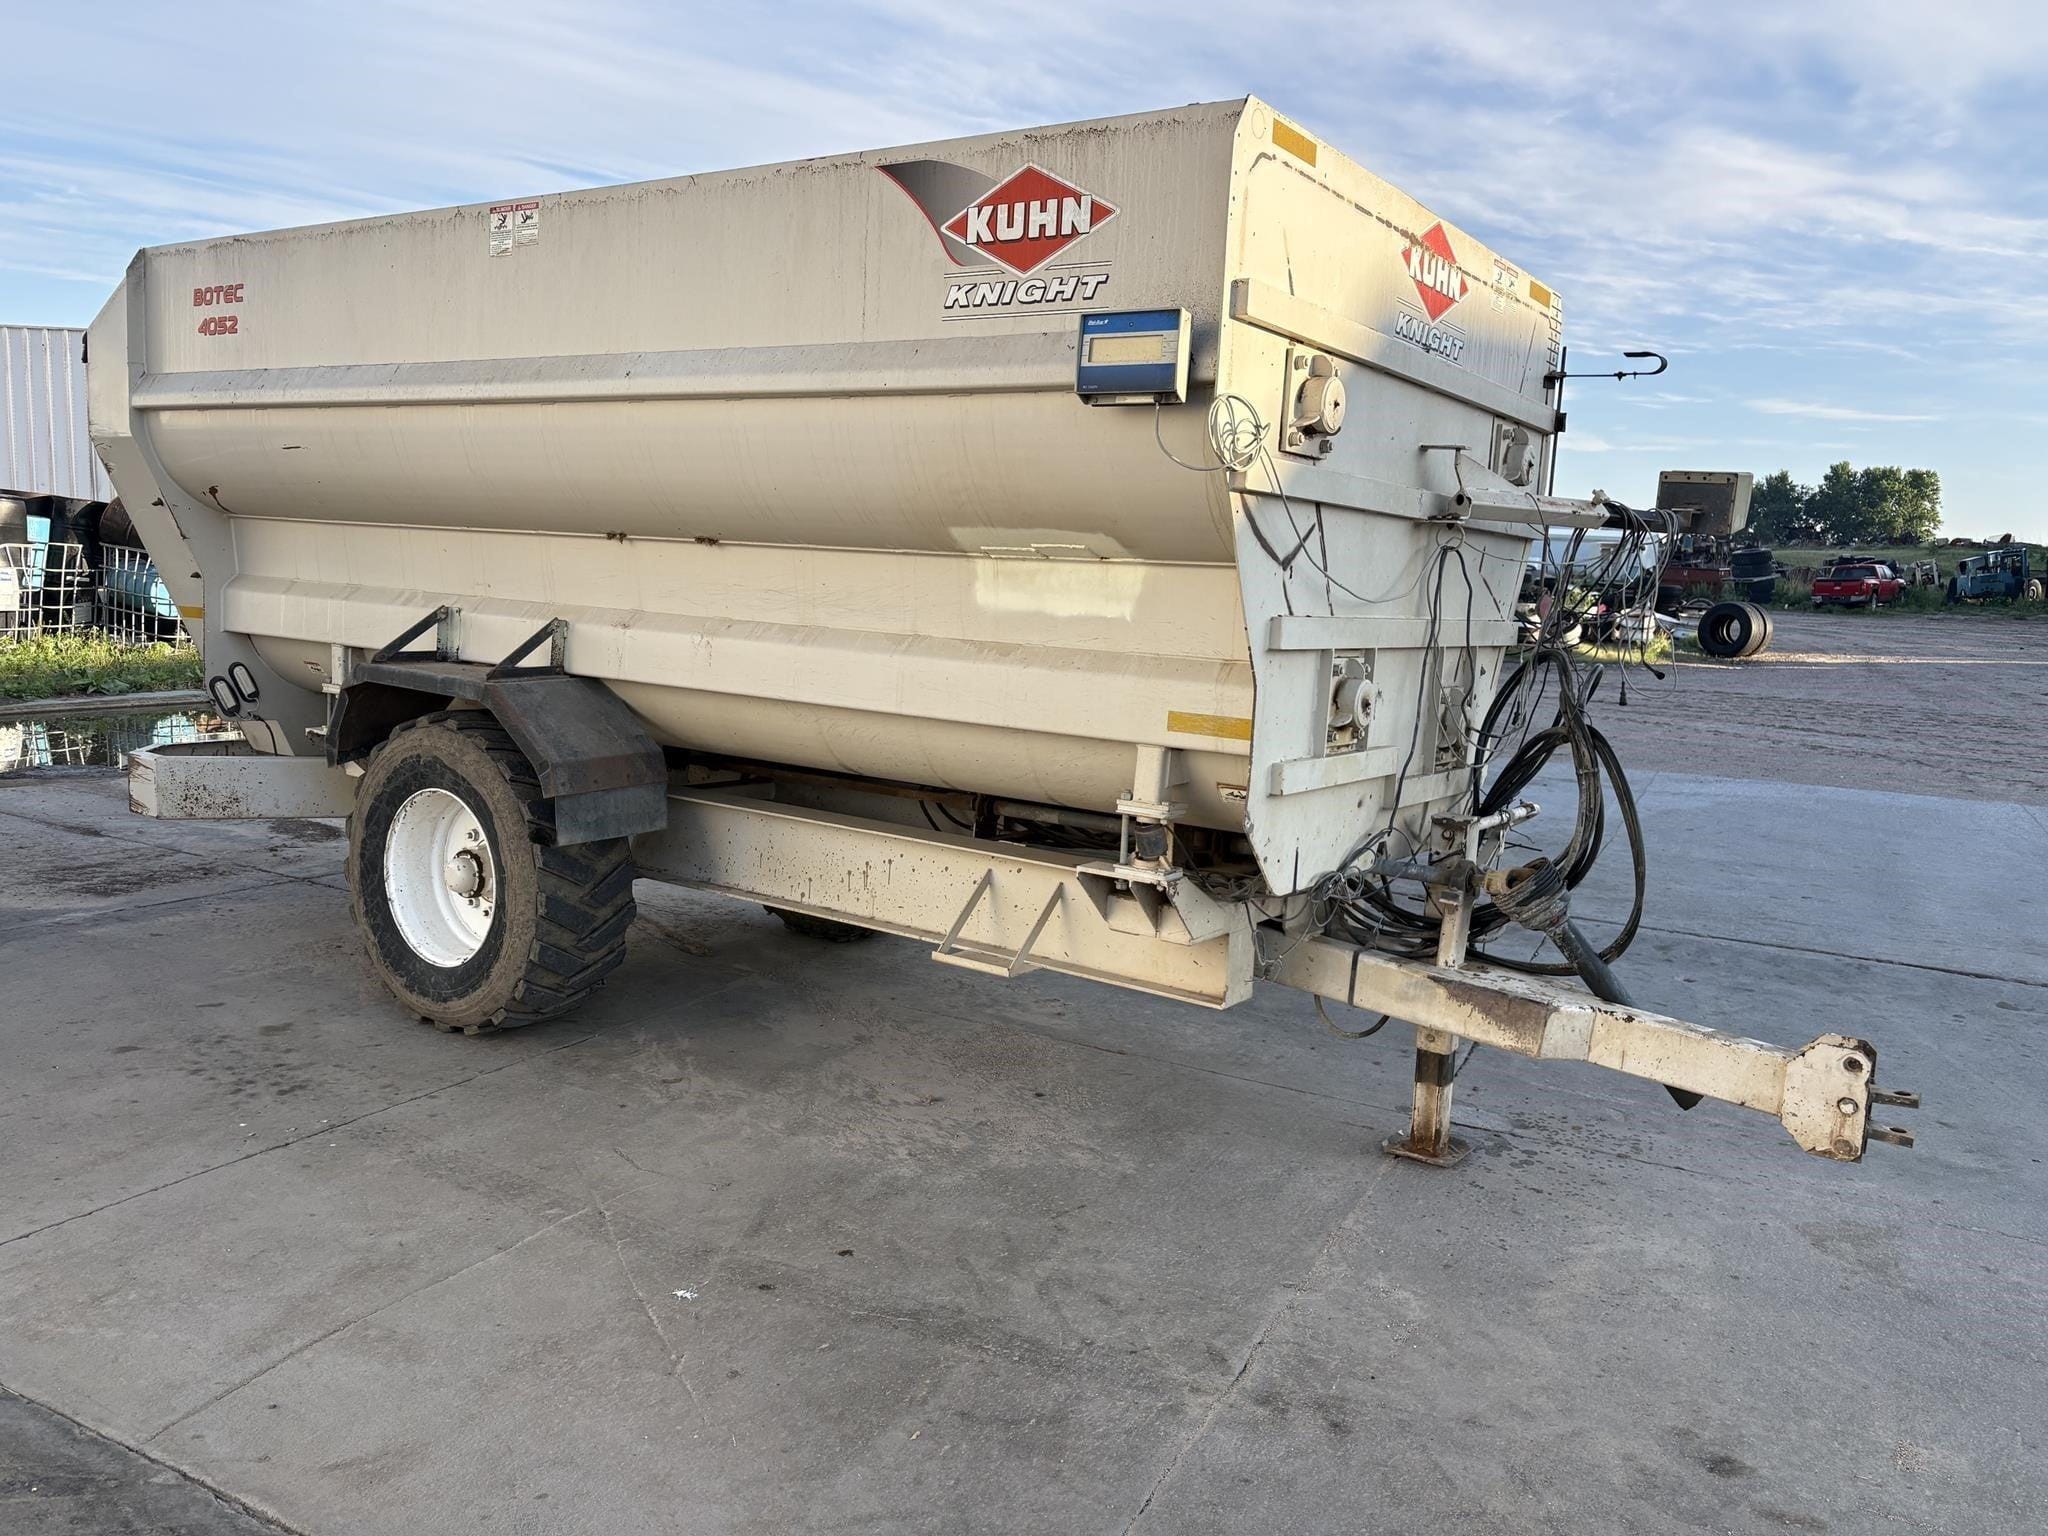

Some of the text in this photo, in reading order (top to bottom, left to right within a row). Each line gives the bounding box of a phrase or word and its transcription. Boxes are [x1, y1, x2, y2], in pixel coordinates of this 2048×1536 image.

[966, 194, 1092, 244] KUHN
[193, 283, 244, 306] BOTEC
[944, 274, 1109, 308] KNIGHT
[1409, 244, 1463, 303] KUHN
[198, 315, 238, 336] 4052
[1395, 311, 1465, 361] KNIGHT
